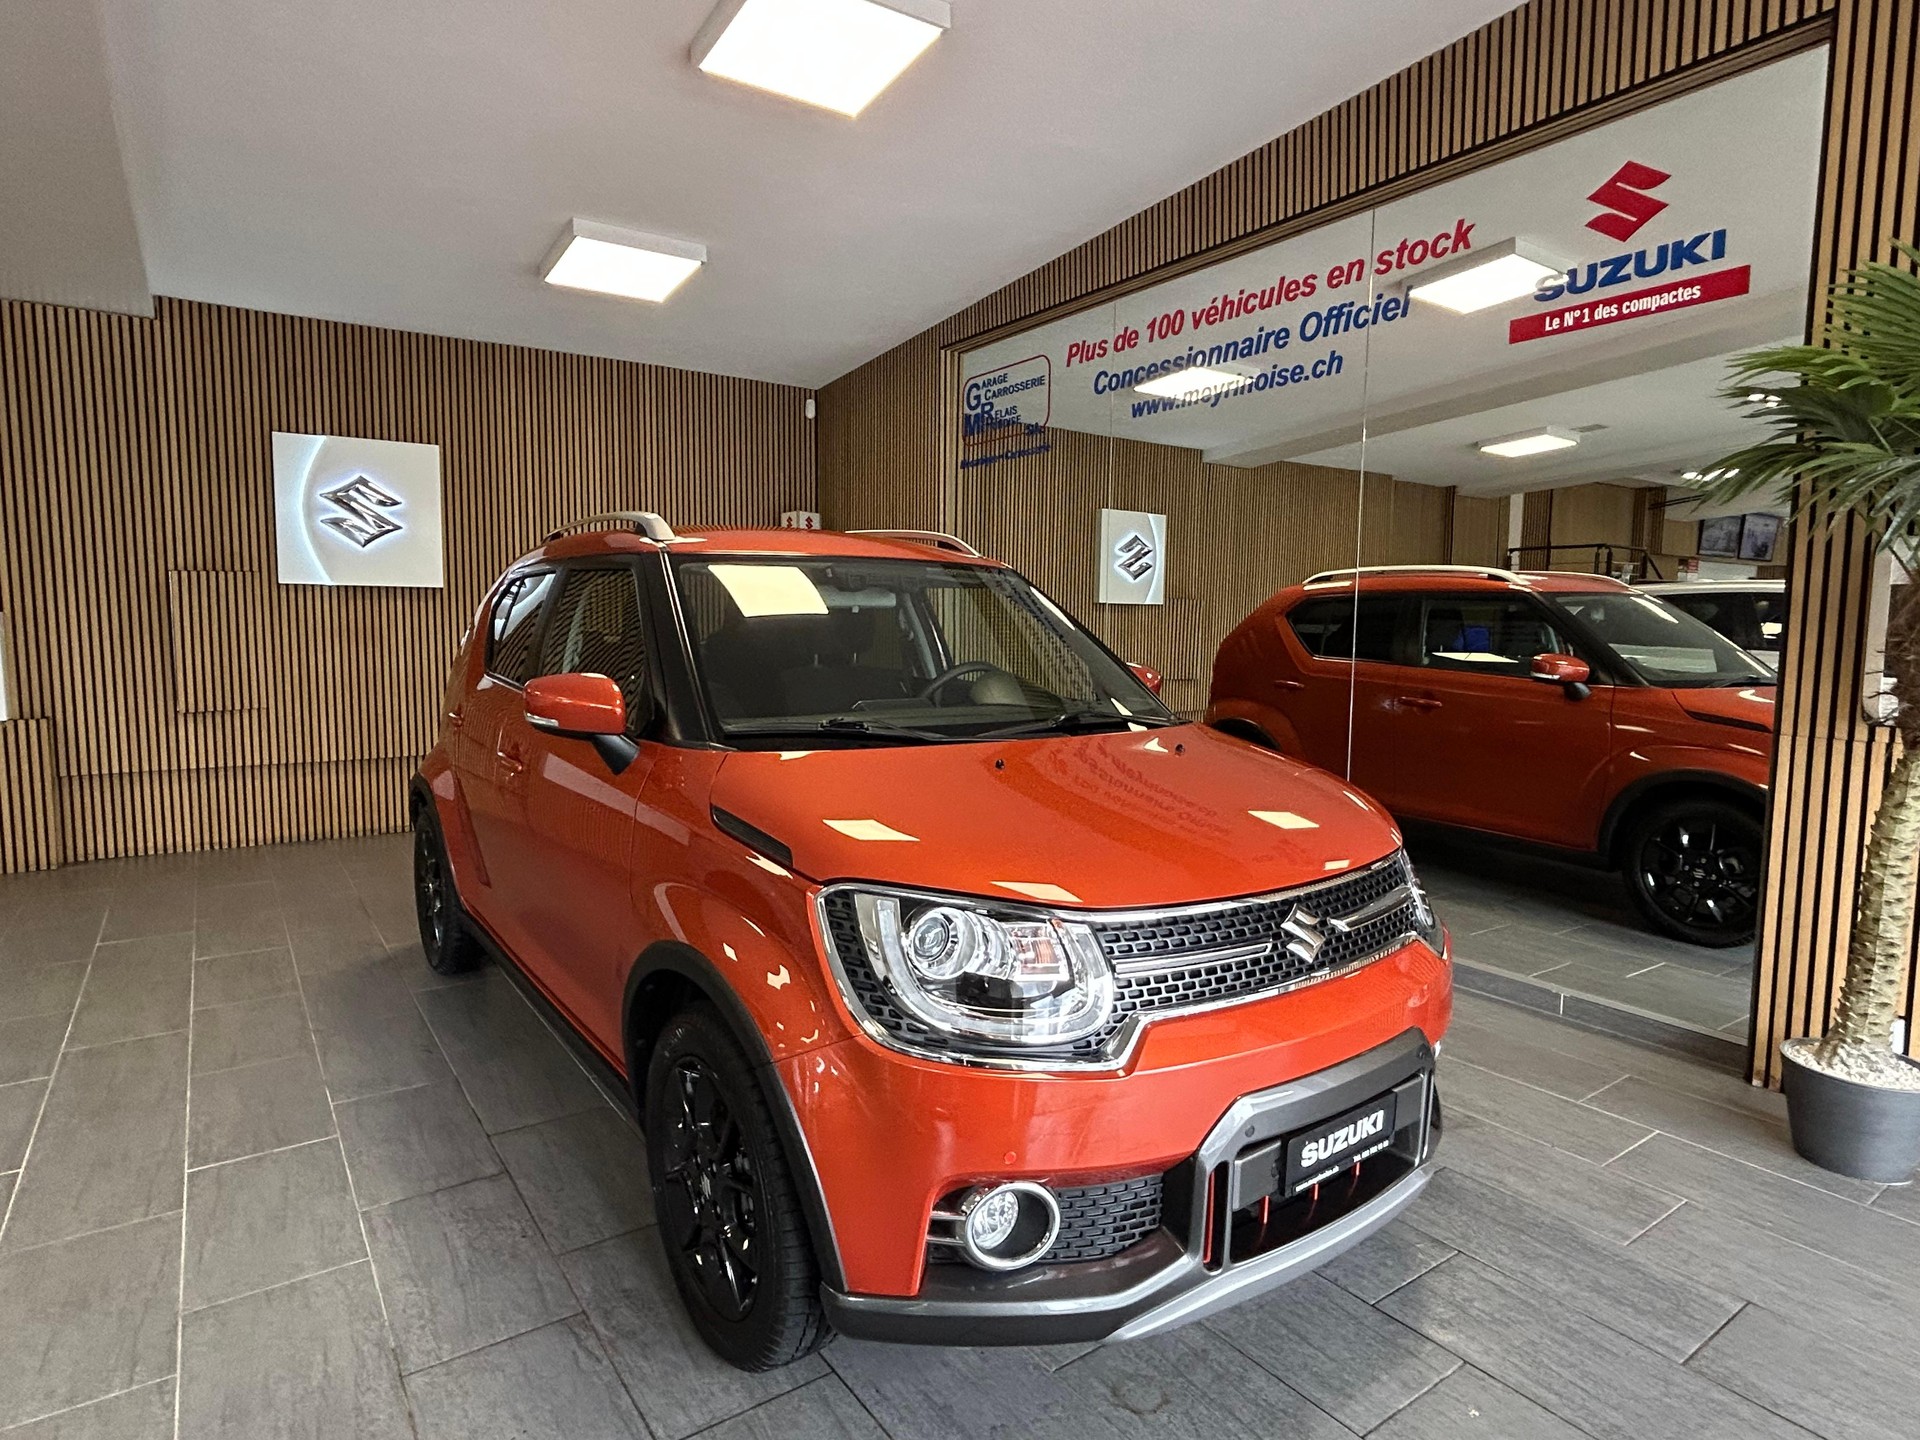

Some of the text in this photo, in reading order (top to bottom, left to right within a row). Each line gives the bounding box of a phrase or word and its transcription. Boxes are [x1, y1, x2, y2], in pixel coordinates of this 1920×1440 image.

[1066, 218, 1476, 367] Plus de 100 véhicules en stock
[1533, 228, 1728, 303] SUZUKI
[1093, 284, 1413, 396] Concessionnaire Officiel
[1544, 284, 1702, 332] Le N°1 des compactes
[984, 374, 1046, 402] CARROSSERIE
[1131, 350, 1344, 419] www.meyrinoise.ch
[1300, 1109, 1385, 1168] SUZUKI
